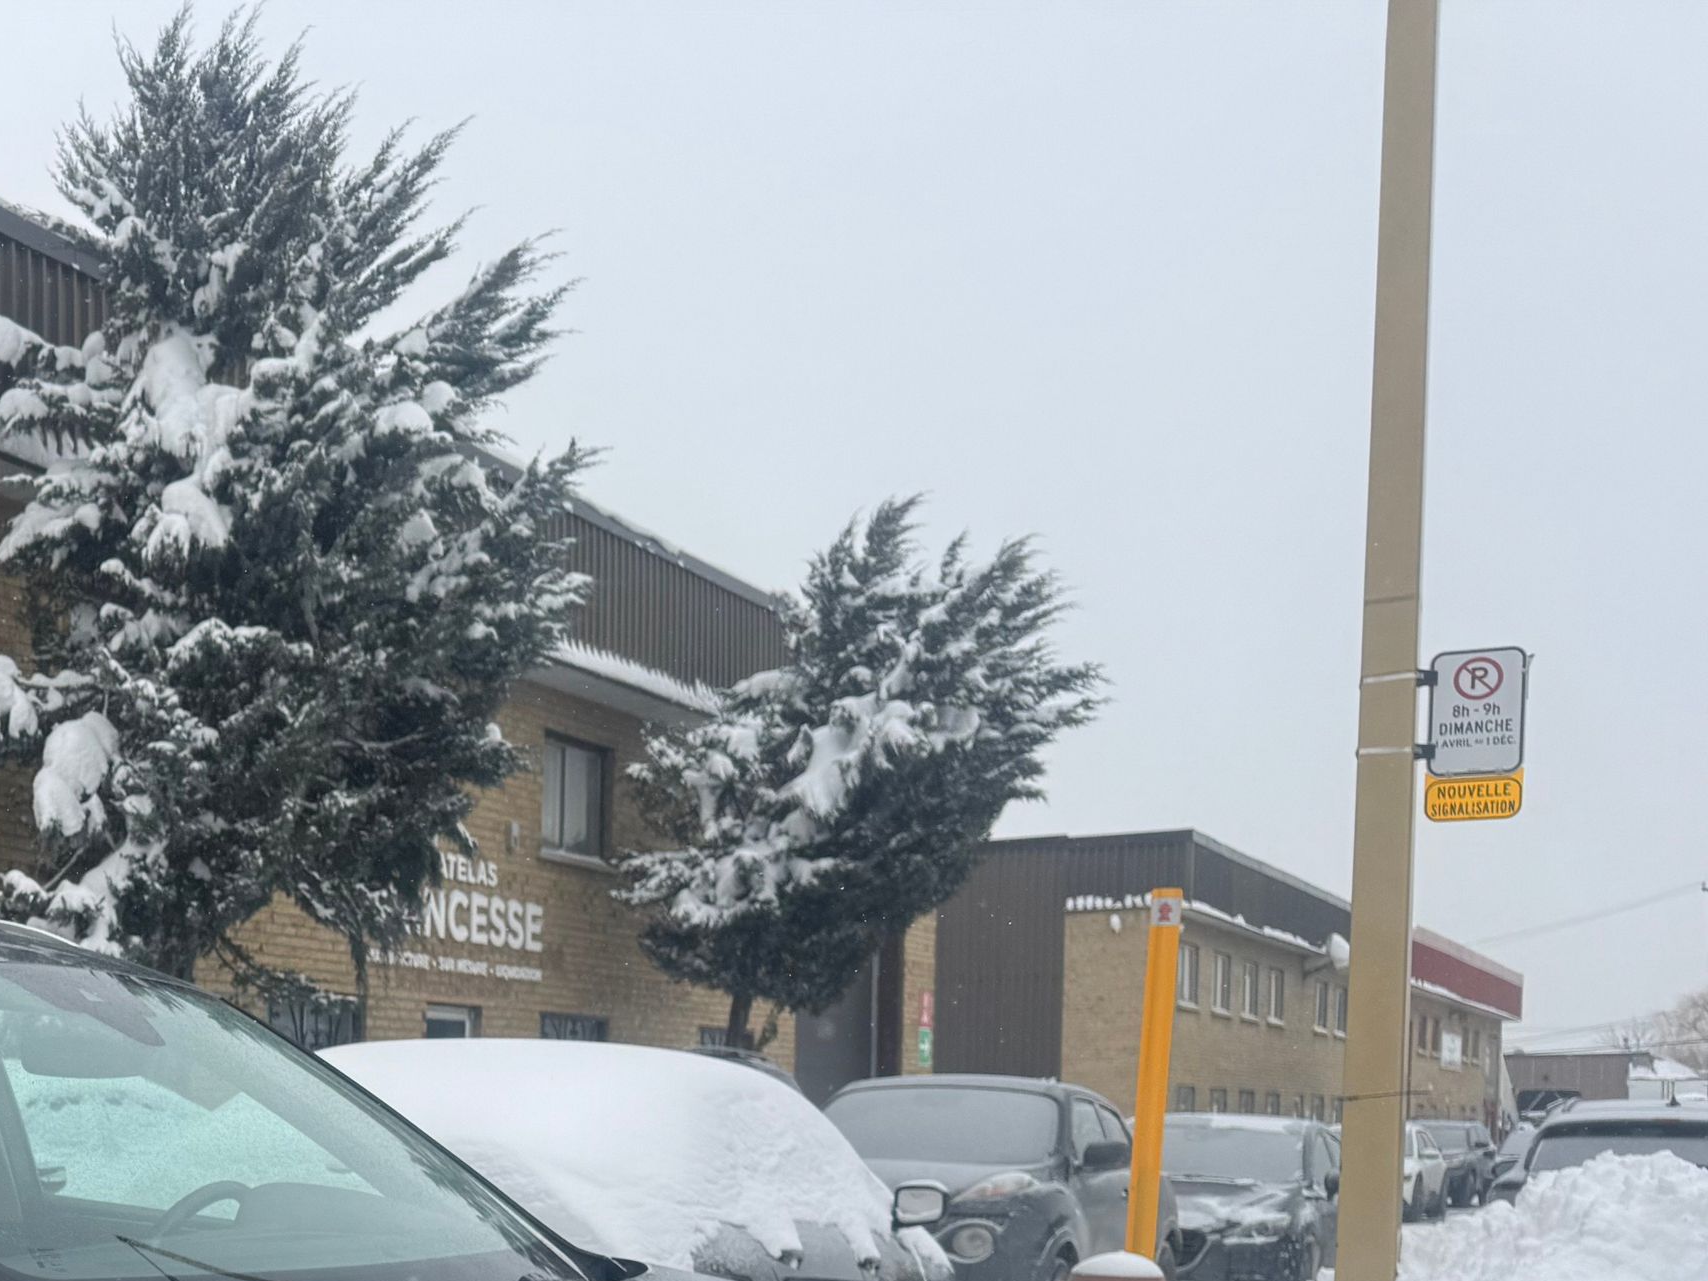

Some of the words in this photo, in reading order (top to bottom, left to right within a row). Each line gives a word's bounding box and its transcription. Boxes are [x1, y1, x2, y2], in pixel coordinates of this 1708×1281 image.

[1452, 704, 1470, 718] 8h
[1482, 702, 1501, 716] 9h
[1439, 718, 1513, 735] DIMANCHE
[1440, 737, 1473, 750] AVRIL
[1437, 782, 1512, 799] NOUVELLE
[1431, 800, 1515, 817] SIGNALISATION
[405, 886, 543, 952] NCESSE
